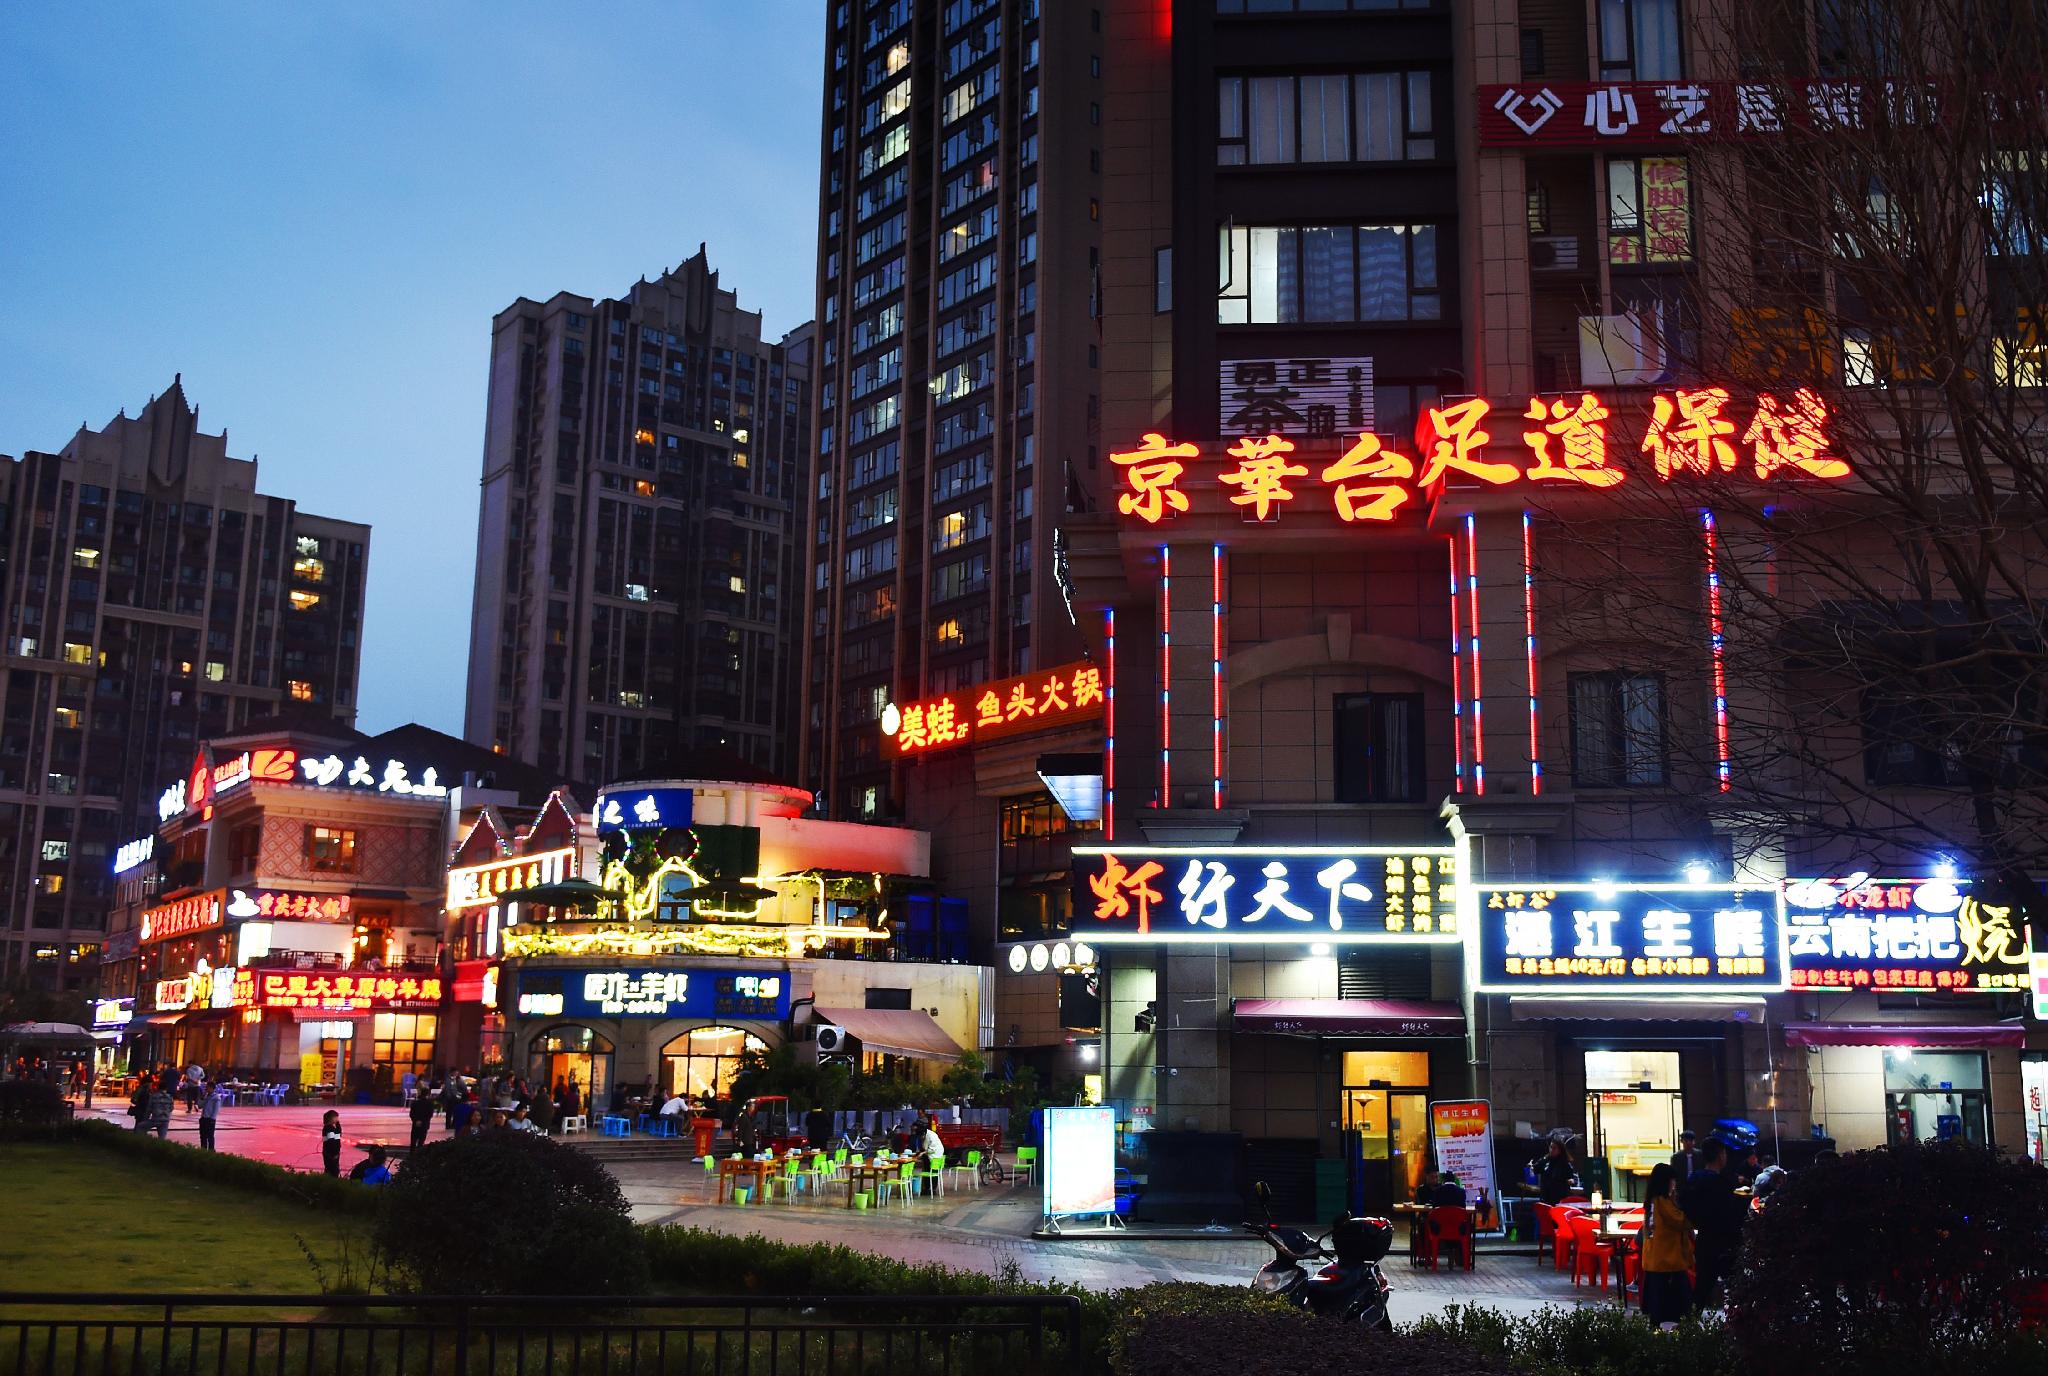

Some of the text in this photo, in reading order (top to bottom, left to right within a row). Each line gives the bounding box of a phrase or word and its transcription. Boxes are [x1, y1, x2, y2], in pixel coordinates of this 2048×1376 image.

[1418, 388, 1852, 487] 足道保健
[899, 698, 955, 751] 美蛙
[976, 667, 1103, 728] 鱼头火锅
[1089, 852, 1373, 934] 虾行天下
